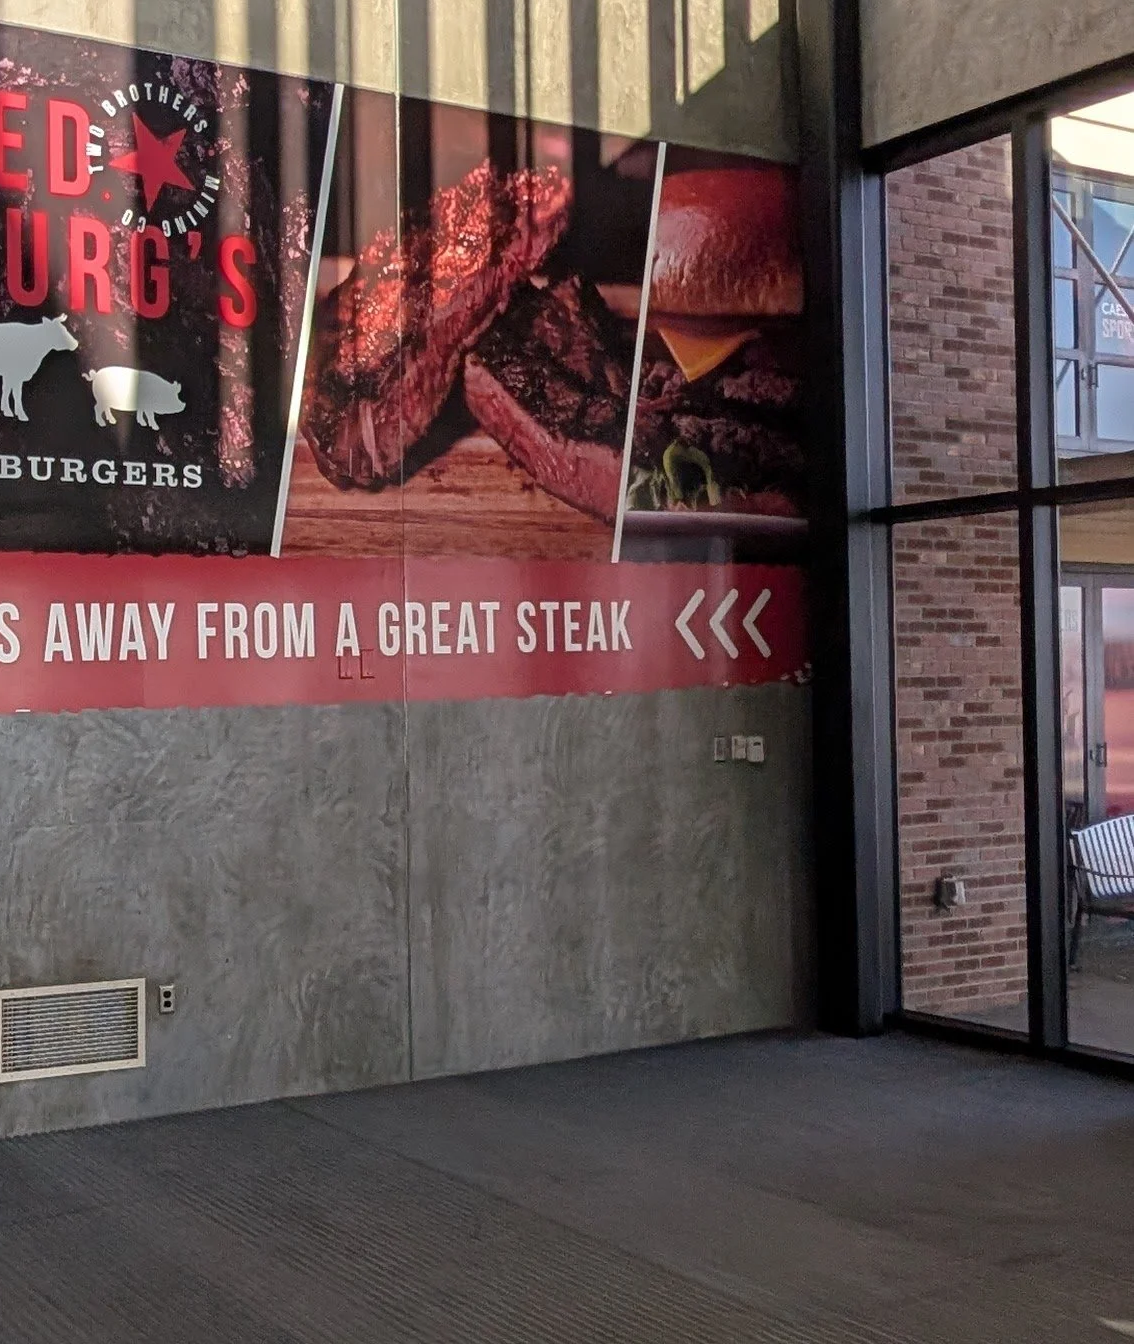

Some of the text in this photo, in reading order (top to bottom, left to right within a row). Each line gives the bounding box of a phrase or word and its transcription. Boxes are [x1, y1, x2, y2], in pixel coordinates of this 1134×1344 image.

[85, 82, 208, 175] TWO BROTHERS
[162, 175, 220, 238] MINING
[43, 601, 177, 662] AWAY
[197, 602, 316, 659] FROM
[335, 602, 361, 657] A
[378, 600, 501, 657] GREAT
[516, 600, 634, 654] STEAK
